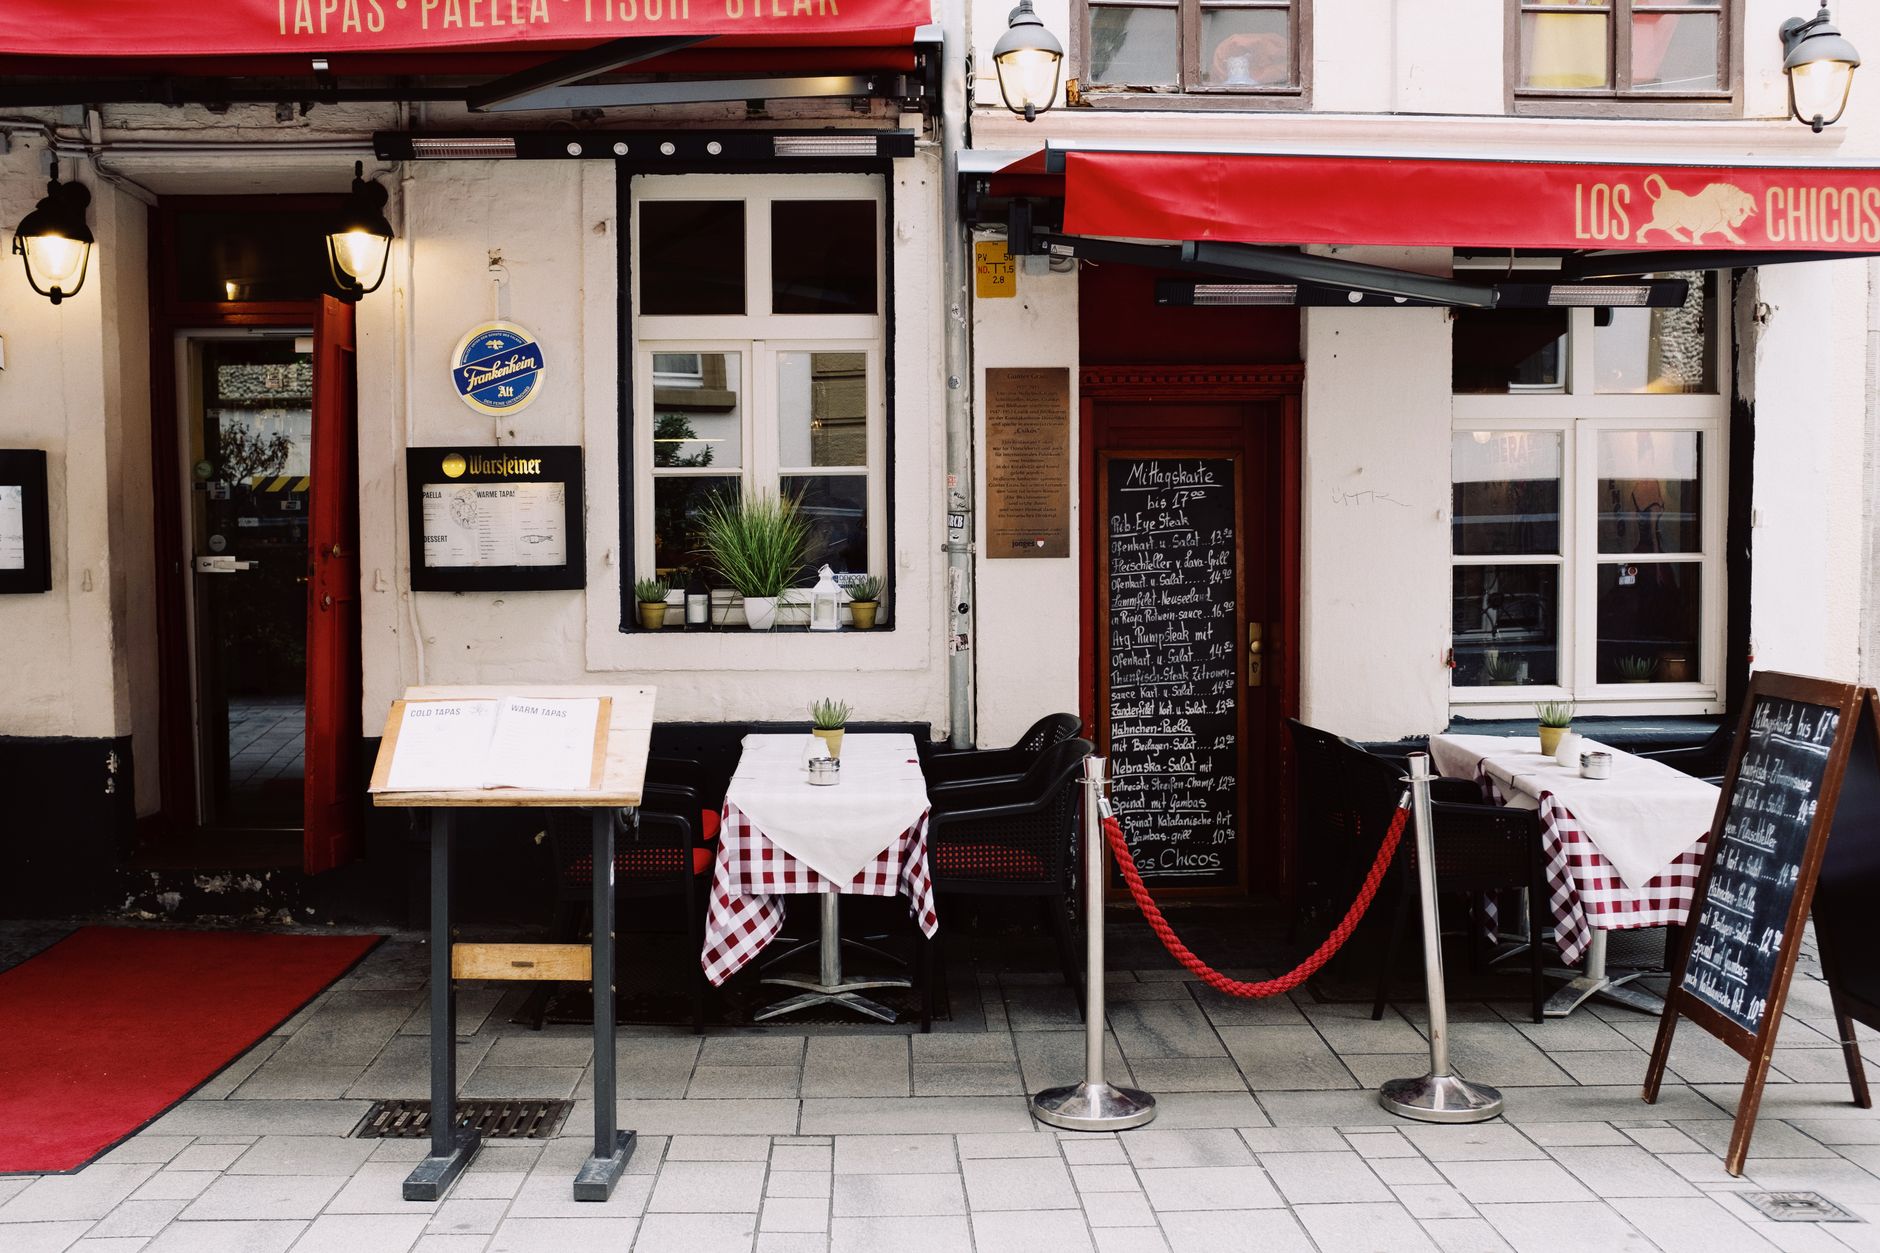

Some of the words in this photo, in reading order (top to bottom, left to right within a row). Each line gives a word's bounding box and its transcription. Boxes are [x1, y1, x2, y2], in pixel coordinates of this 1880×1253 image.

[1576, 183, 1630, 240] LOS
[1766, 186, 1880, 243] CHICOS
[992, 276, 1005, 284] 2.8
[463, 354, 537, 392] Frankenheim
[498, 385, 514, 397] Alt
[469, 453, 542, 477] Warsteiner
[1126, 461, 1215, 492] Mittagskarte
[423, 491, 442, 499] PAELLA
[476, 490, 498, 499] WARME
[1148, 494, 1167, 510] bis
[1159, 510, 1190, 529] Steak
[424, 535, 447, 543] DESSERT
[1172, 531, 1200, 548] Salat
[1112, 552, 1172, 572] Fleischteller
[1159, 569, 1184, 585] Salat
[1121, 609, 1143, 629] Rioja
[1137, 621, 1190, 650] Rumpsteak
[1195, 622, 1214, 642] mit
[1168, 648, 1194, 664] Salat
[1111, 690, 1136, 701] sauce
[1171, 683, 1194, 697] Salat
[410, 708, 432, 717] COLD
[434, 707, 462, 716] TAPAS
[511, 704, 539, 715] WARM
[541, 708, 568, 718] TAPAS
[1111, 701, 1155, 717] Zanderfilet
[1184, 700, 1208, 715] Salat
[1112, 718, 1193, 736] Hähnchen-Paella
[1797, 708, 1811, 738] bis
[1112, 739, 1128, 752] mit
[1112, 753, 1197, 774] Nebraska-Salat
[1199, 756, 1213, 773] mit
[1112, 791, 1146, 814] Spinat
[1151, 793, 1166, 809] mit
[1169, 793, 1207, 813] Gambas
[1732, 786, 1744, 807] mit
[1765, 794, 1786, 816] Salat
[1124, 812, 1153, 831] Spinat
[1216, 810, 1232, 826] Art
[1160, 848, 1221, 868] Chicos
[1715, 844, 1728, 865] mit
[1745, 855, 1764, 878] Salat
[1700, 907, 1712, 926] mit
[1731, 986, 1744, 1015] Art
